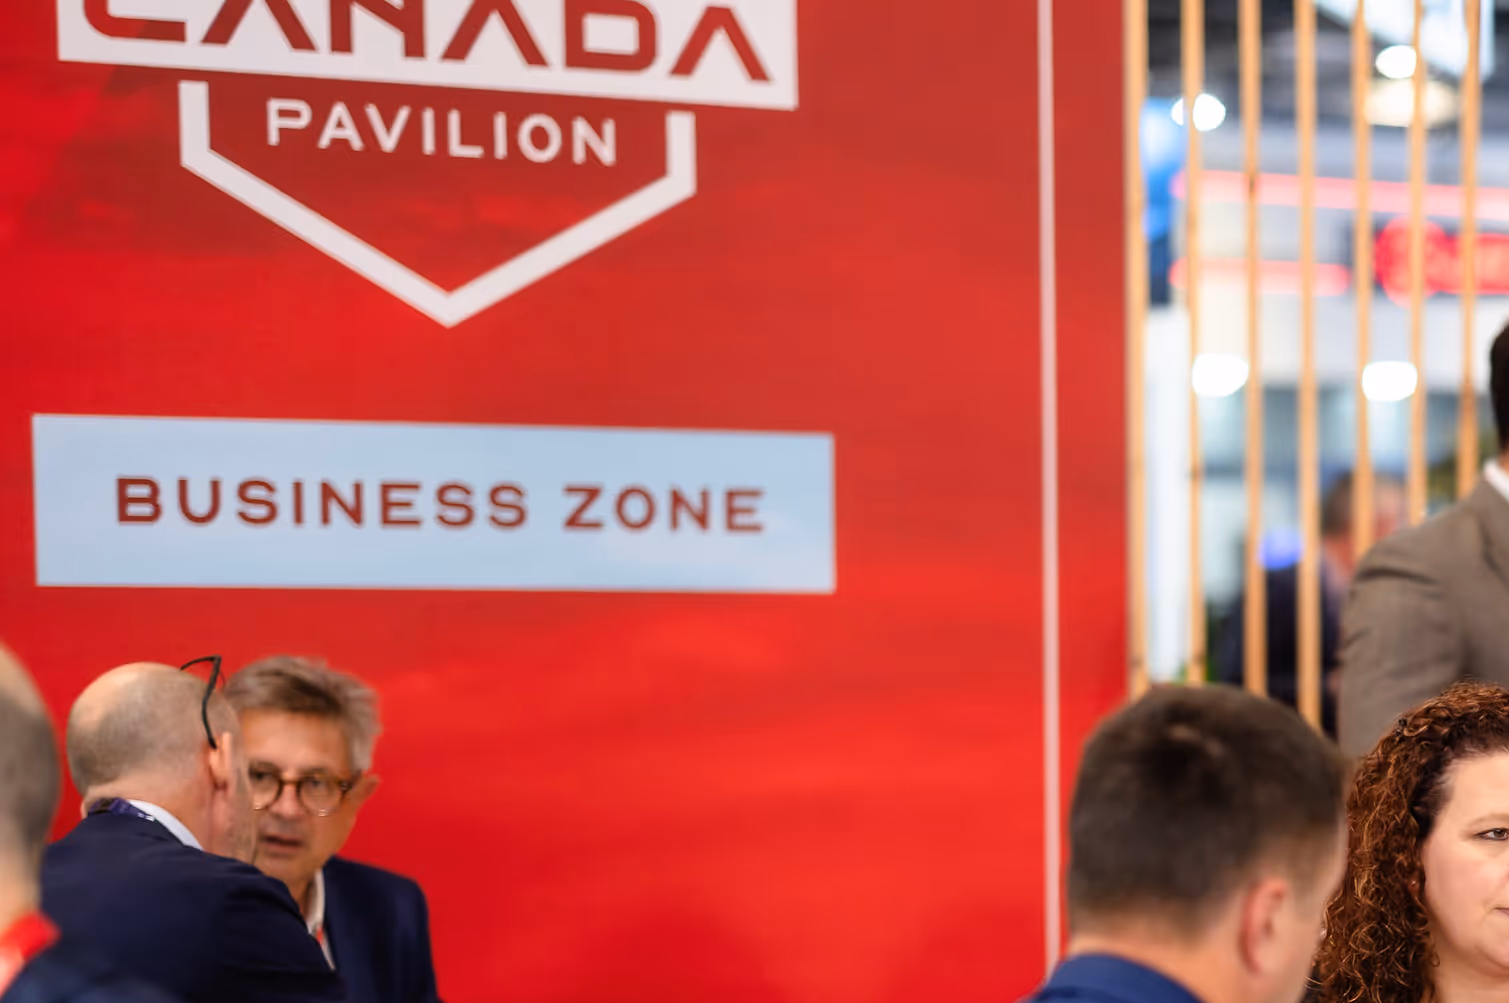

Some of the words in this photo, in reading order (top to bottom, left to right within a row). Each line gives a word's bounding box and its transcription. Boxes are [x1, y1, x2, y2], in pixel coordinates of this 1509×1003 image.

[266, 97, 617, 167] PAVILION
[116, 477, 527, 529] BUSINESS
[563, 486, 762, 532] ZONE
